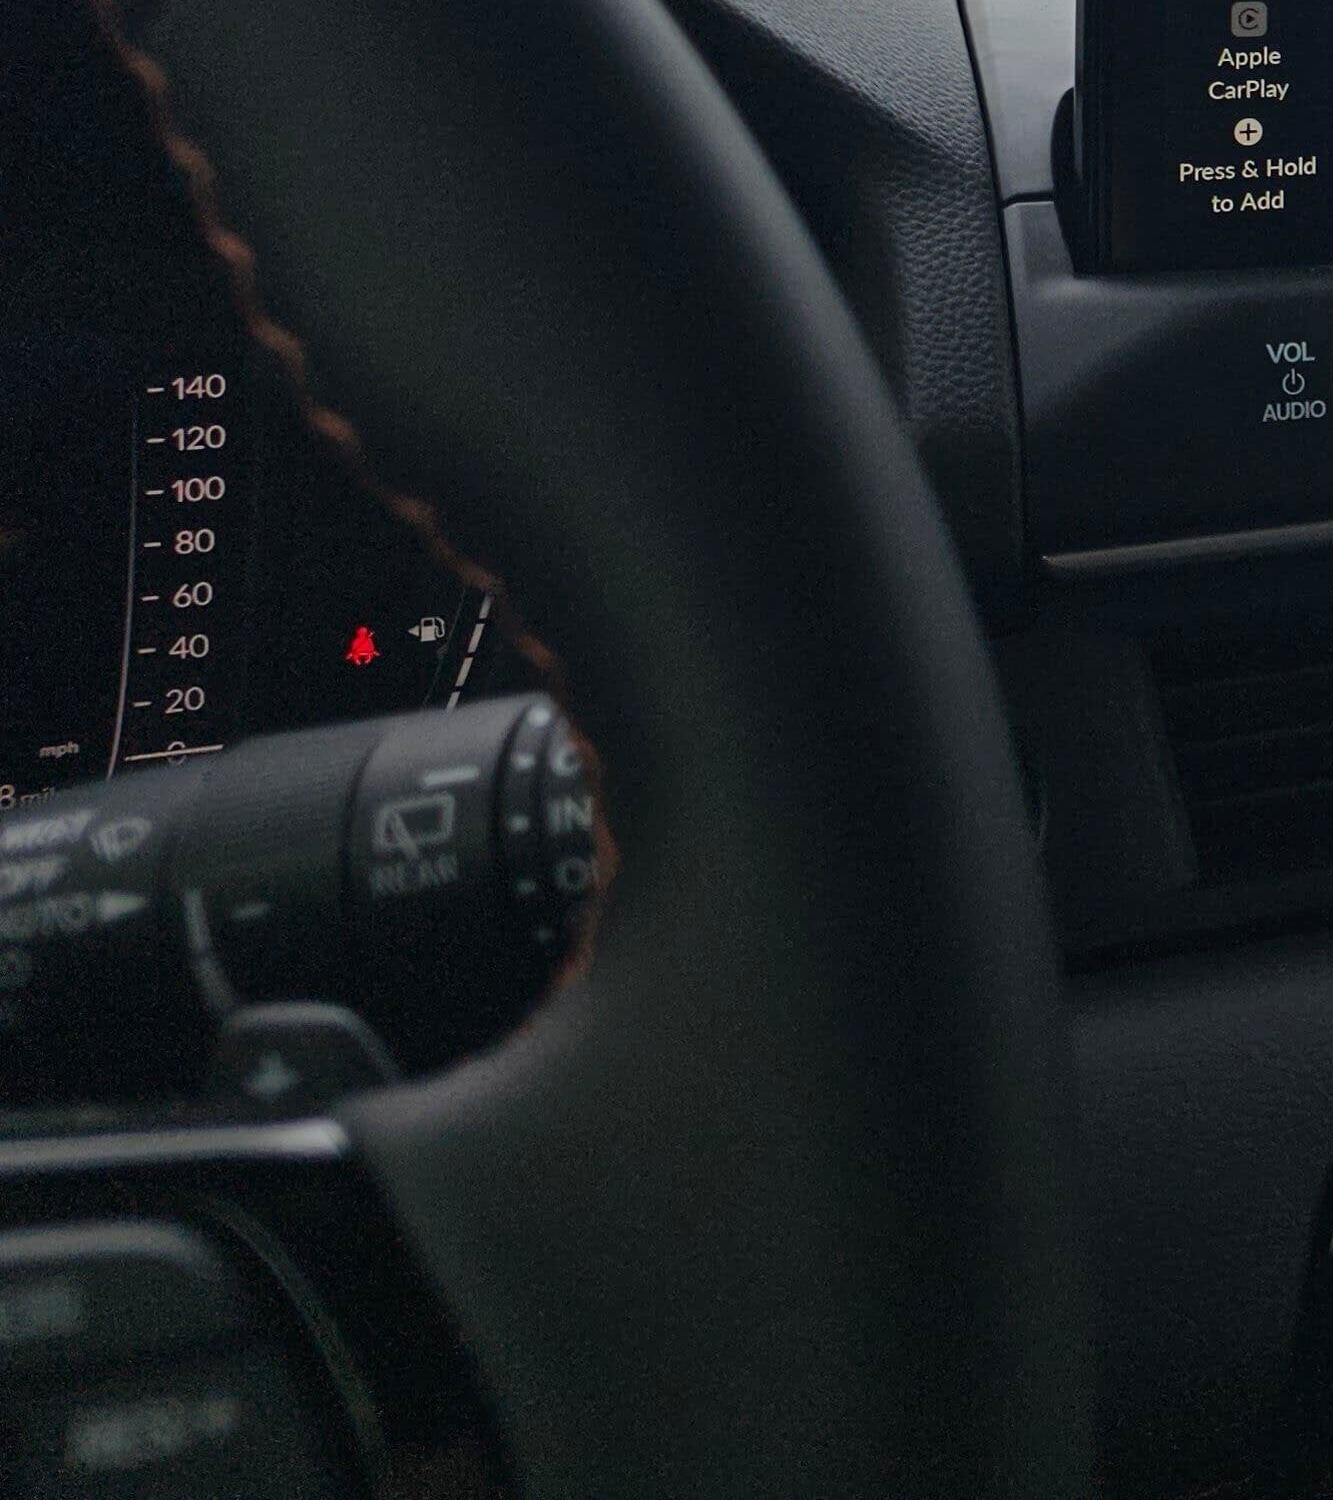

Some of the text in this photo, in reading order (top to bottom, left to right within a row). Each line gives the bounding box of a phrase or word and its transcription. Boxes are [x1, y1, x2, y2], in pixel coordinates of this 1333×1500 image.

[1218, 46, 1281, 69] Apple
[1209, 79, 1289, 100] CarPlay
[1180, 156, 1316, 181] Press & Hold
[1212, 190, 1284, 212] to Add
[1266, 342, 1315, 363] VOL
[172, 374, 225, 399] 140
[1261, 397, 1327, 422] AUDIO
[172, 425, 226, 451] 120
[172, 476, 225, 502] 100
[175, 529, 214, 554] 80
[173, 582, 212, 608] 60
[169, 634, 209, 659] 40
[165, 687, 204, 714] 20
[39, 740, 80, 759] mph
